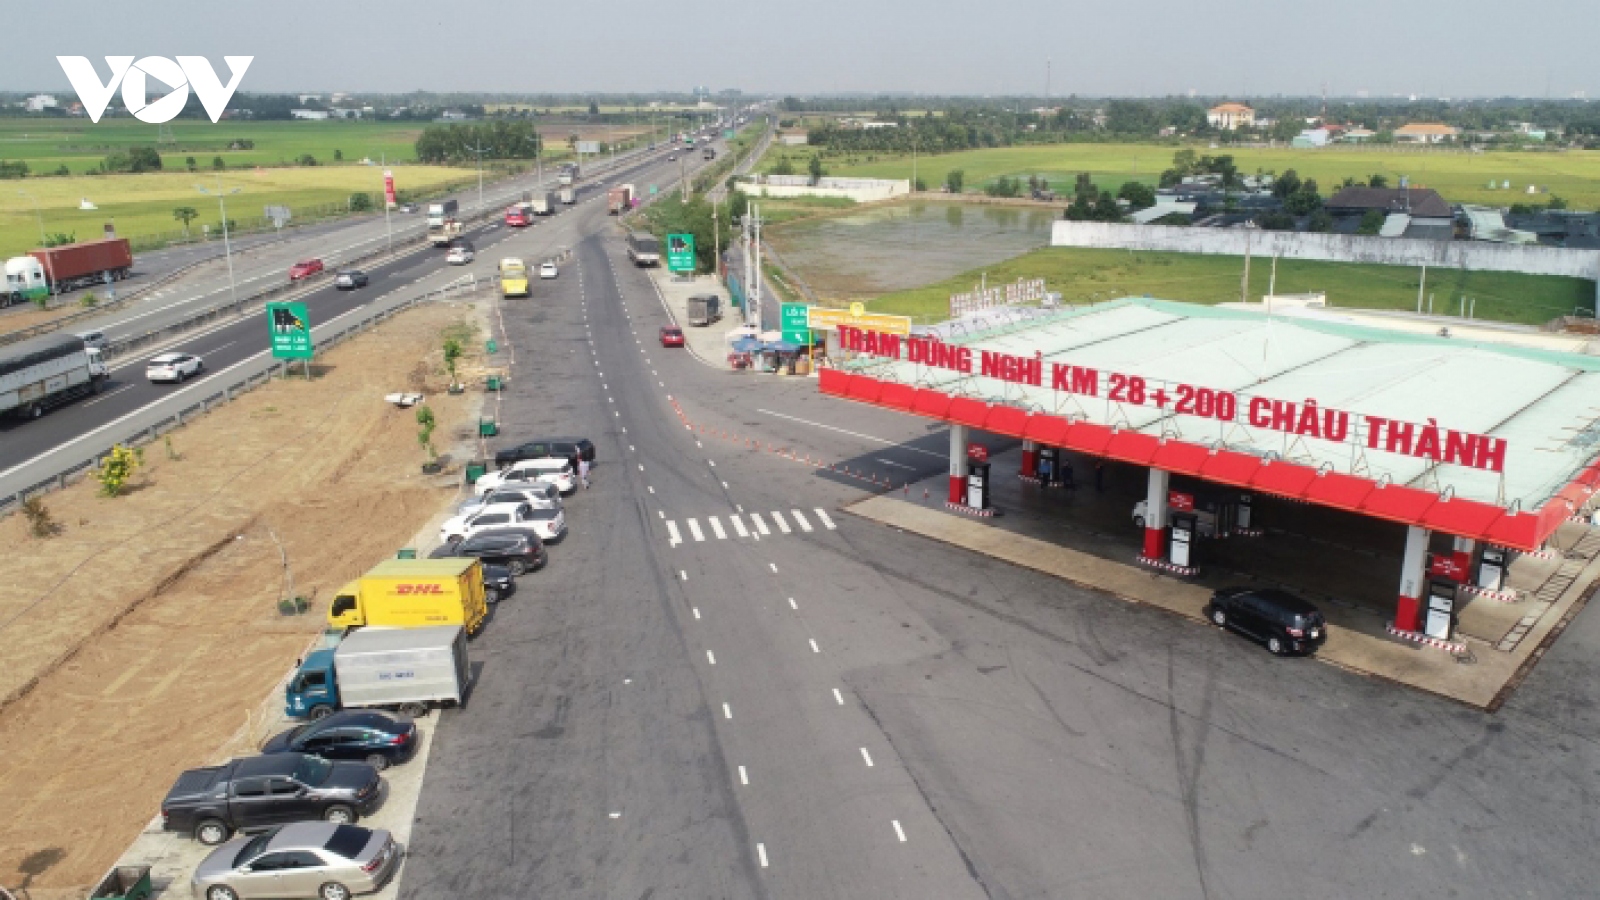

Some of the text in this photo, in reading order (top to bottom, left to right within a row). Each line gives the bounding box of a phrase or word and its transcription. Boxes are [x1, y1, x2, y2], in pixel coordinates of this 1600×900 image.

[981, 349, 1042, 387] NGHỈ
[1052, 362, 1098, 397] KM
[1108, 372, 1237, 422] 28+200
[1249, 397, 1349, 443] CHÂU
[1364, 415, 1508, 474] THÀNH
[396, 583, 444, 596] DHL
